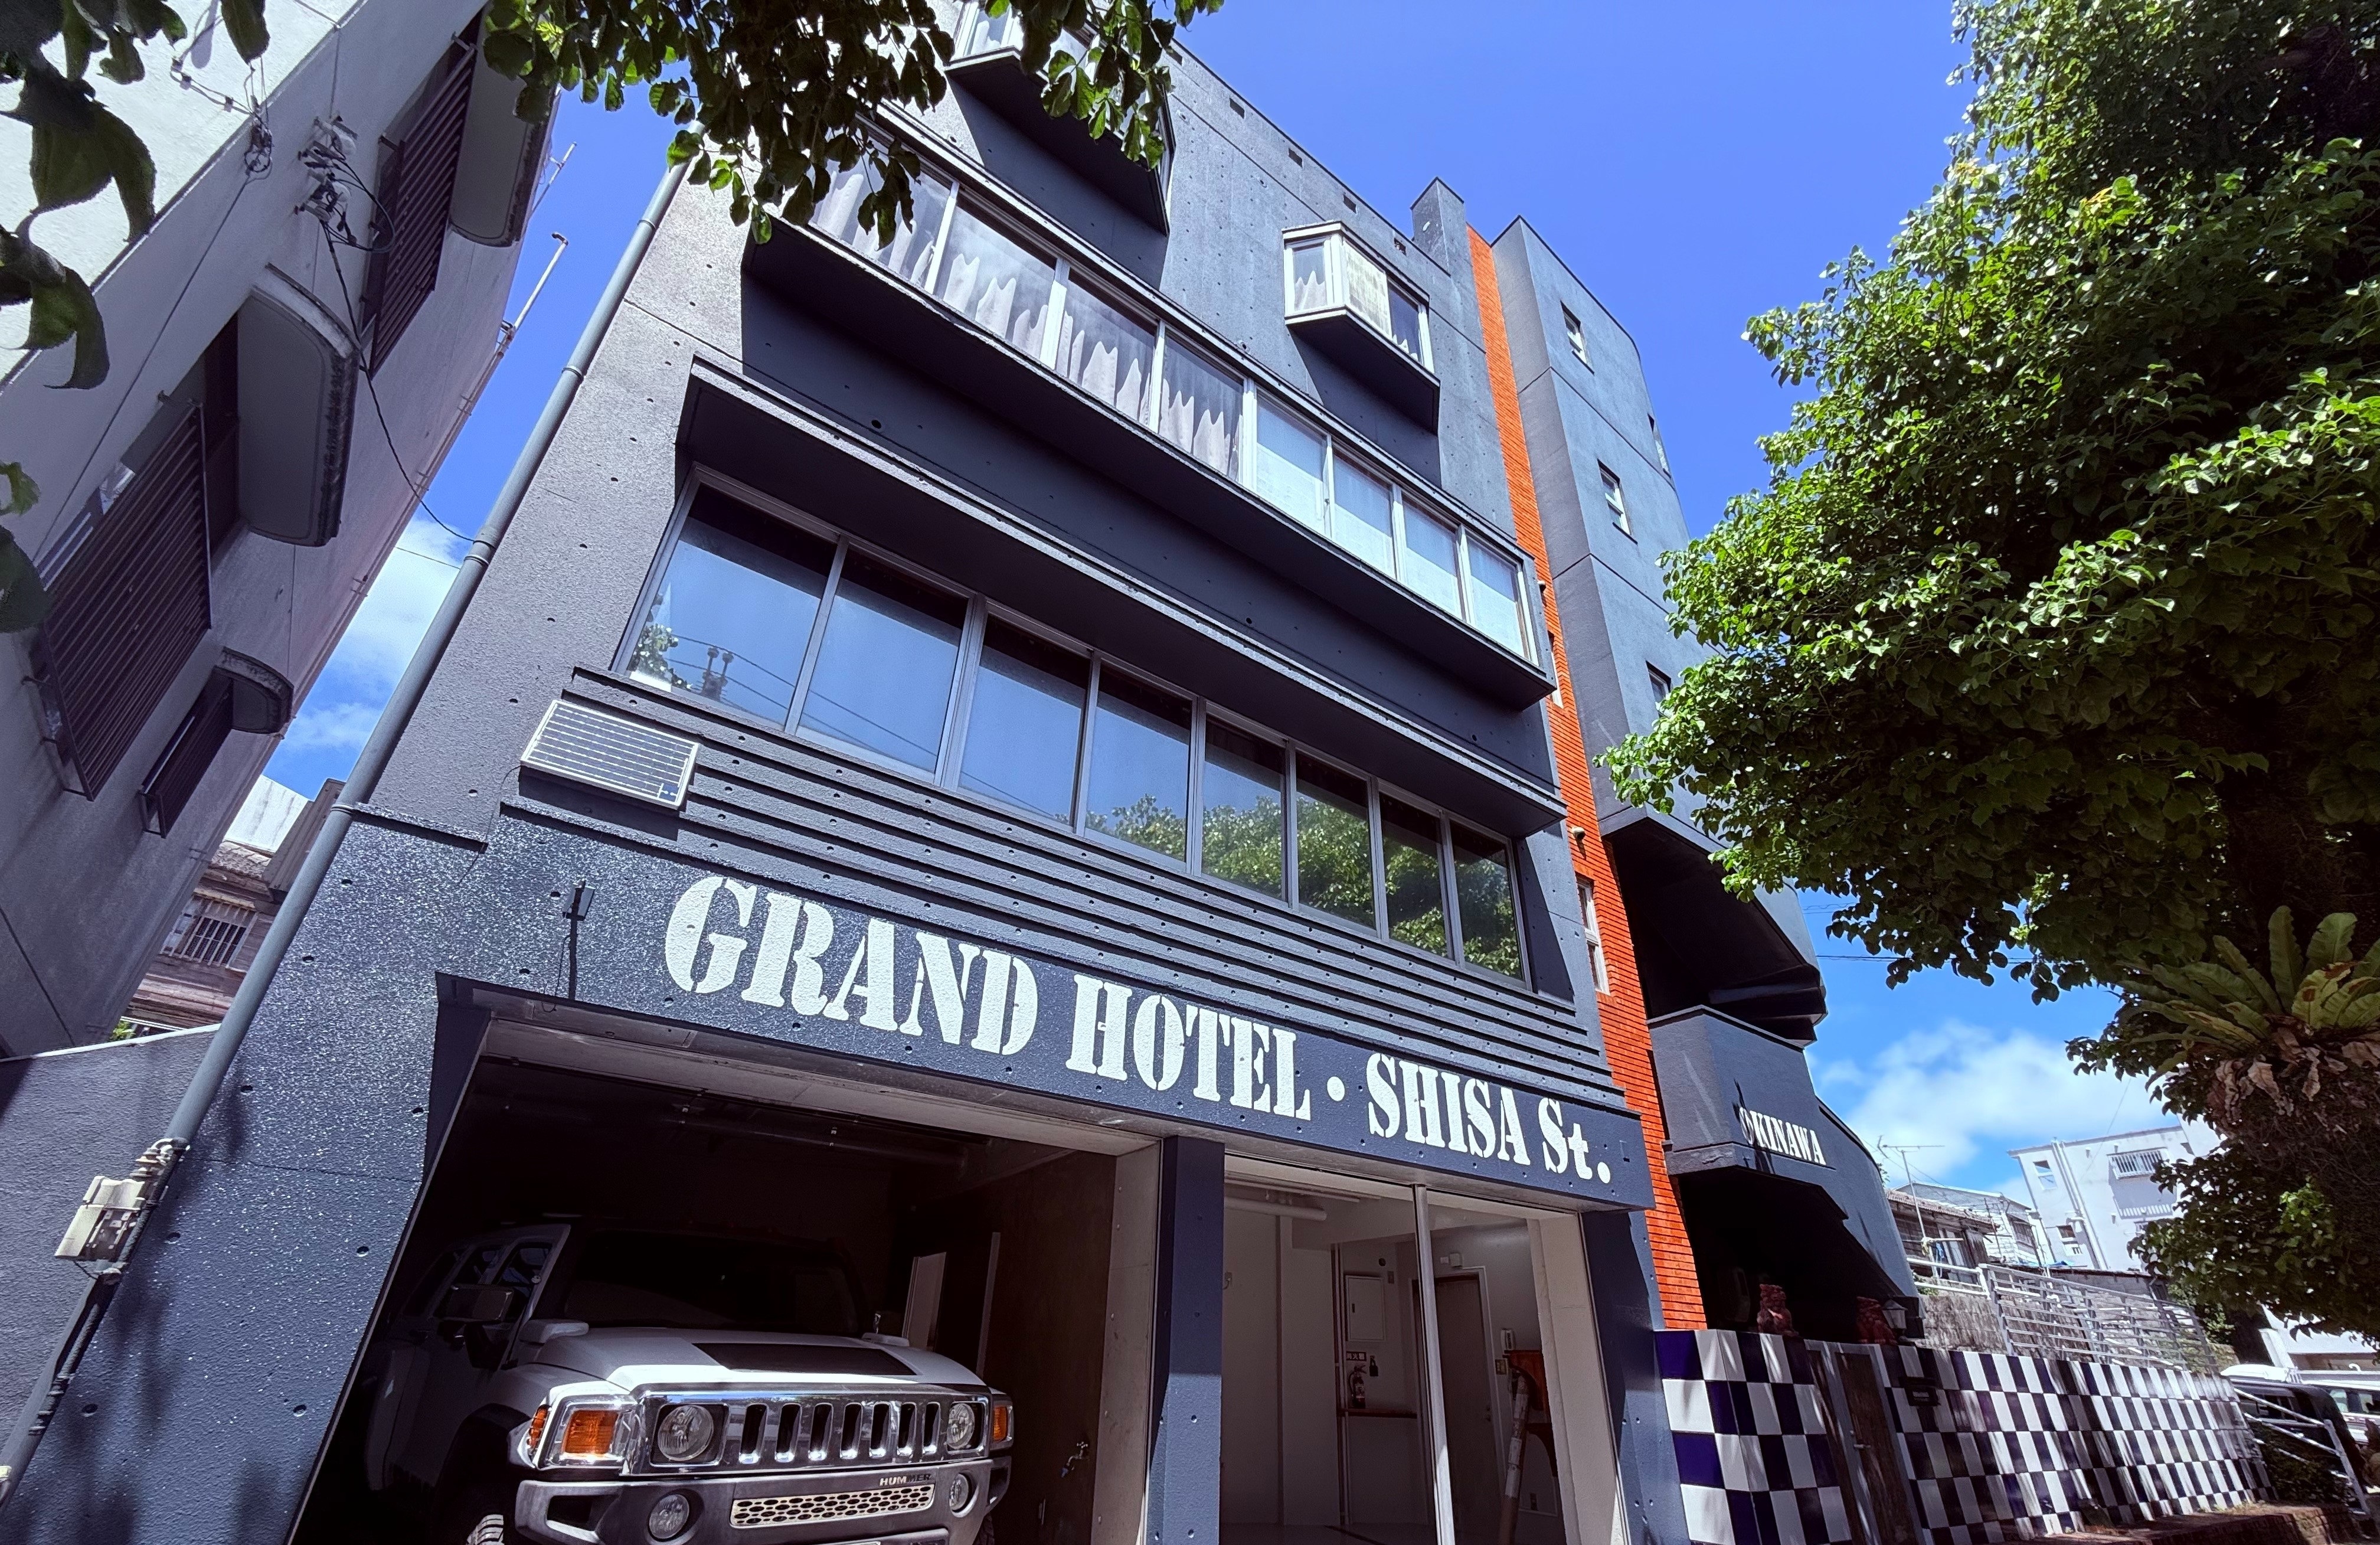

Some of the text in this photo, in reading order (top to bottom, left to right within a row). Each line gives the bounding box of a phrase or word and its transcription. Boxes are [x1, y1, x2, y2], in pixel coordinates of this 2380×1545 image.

[665, 877, 1038, 1055] GRAND
[1065, 974, 1311, 1121] HOTEL
[1366, 1053, 1531, 1165] SHISA
[1538, 1097, 1611, 1184] St.
[1738, 1107, 1826, 1165] OKINAWA
[880, 1474, 931, 1486] HUMMER
